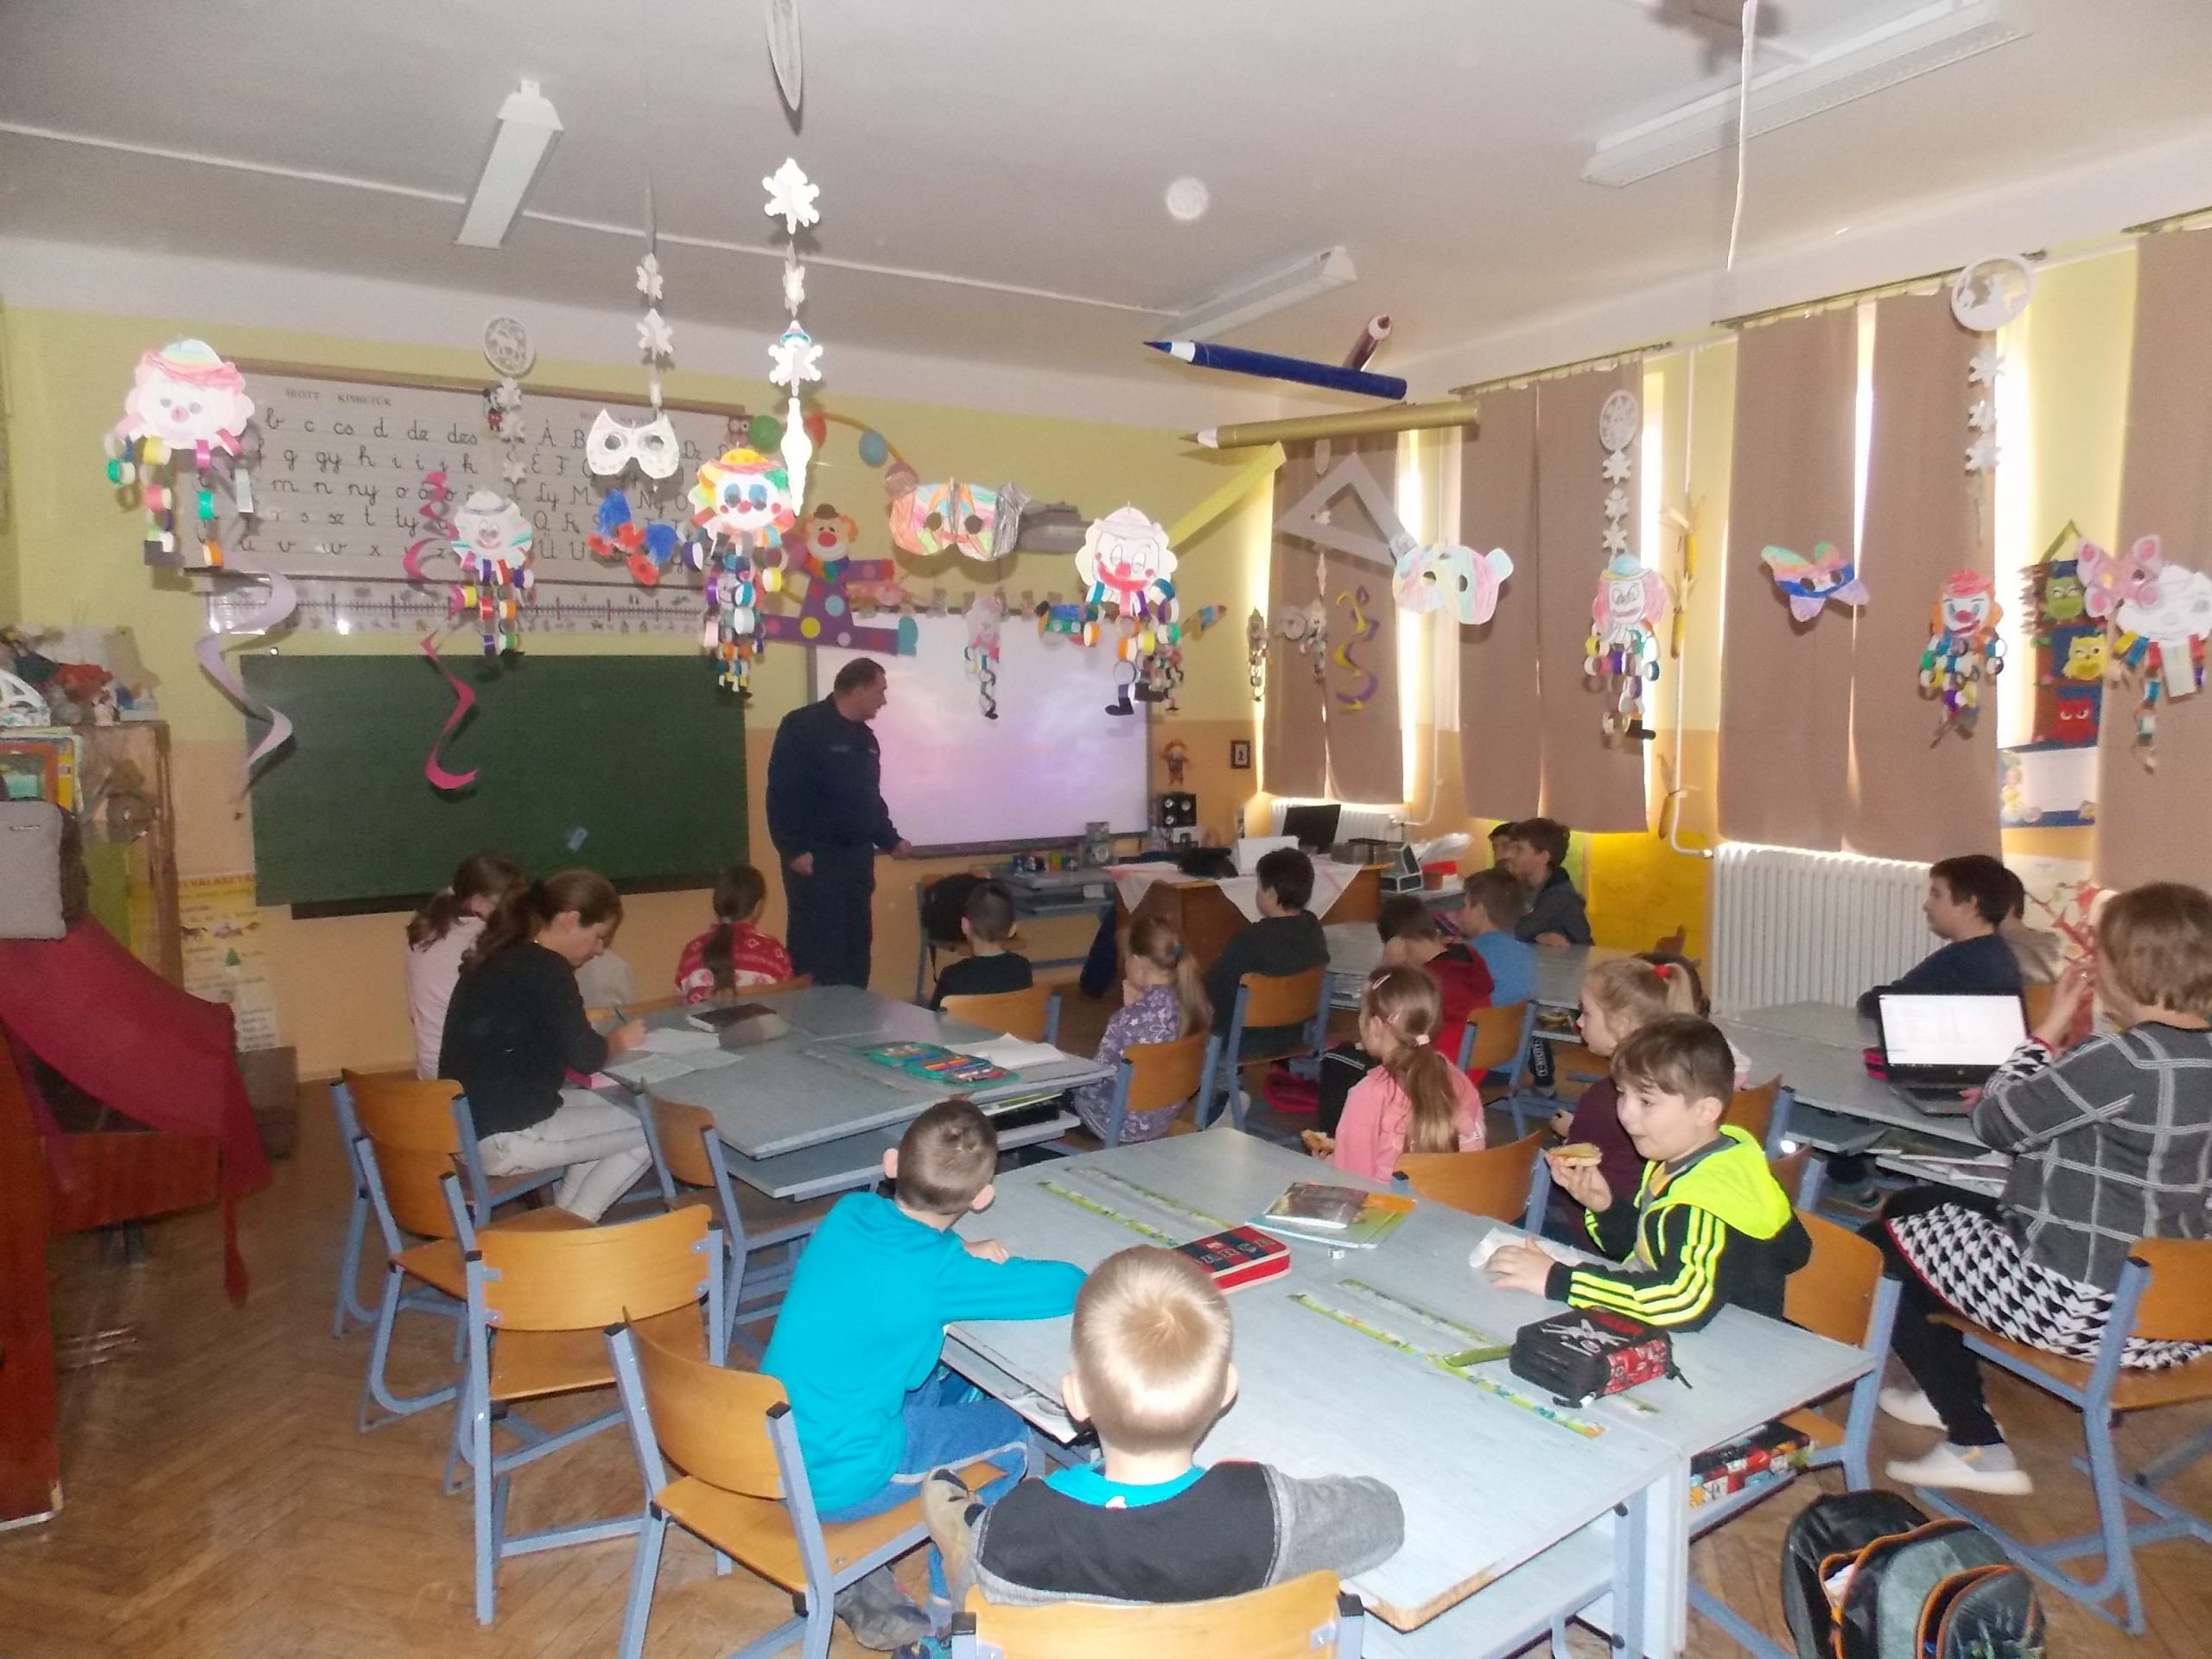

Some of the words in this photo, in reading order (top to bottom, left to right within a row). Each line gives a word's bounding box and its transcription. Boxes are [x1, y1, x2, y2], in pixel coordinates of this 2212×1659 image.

[303, 420, 315, 433] c
[373, 416, 389, 439] d
[270, 480, 299, 493] m
